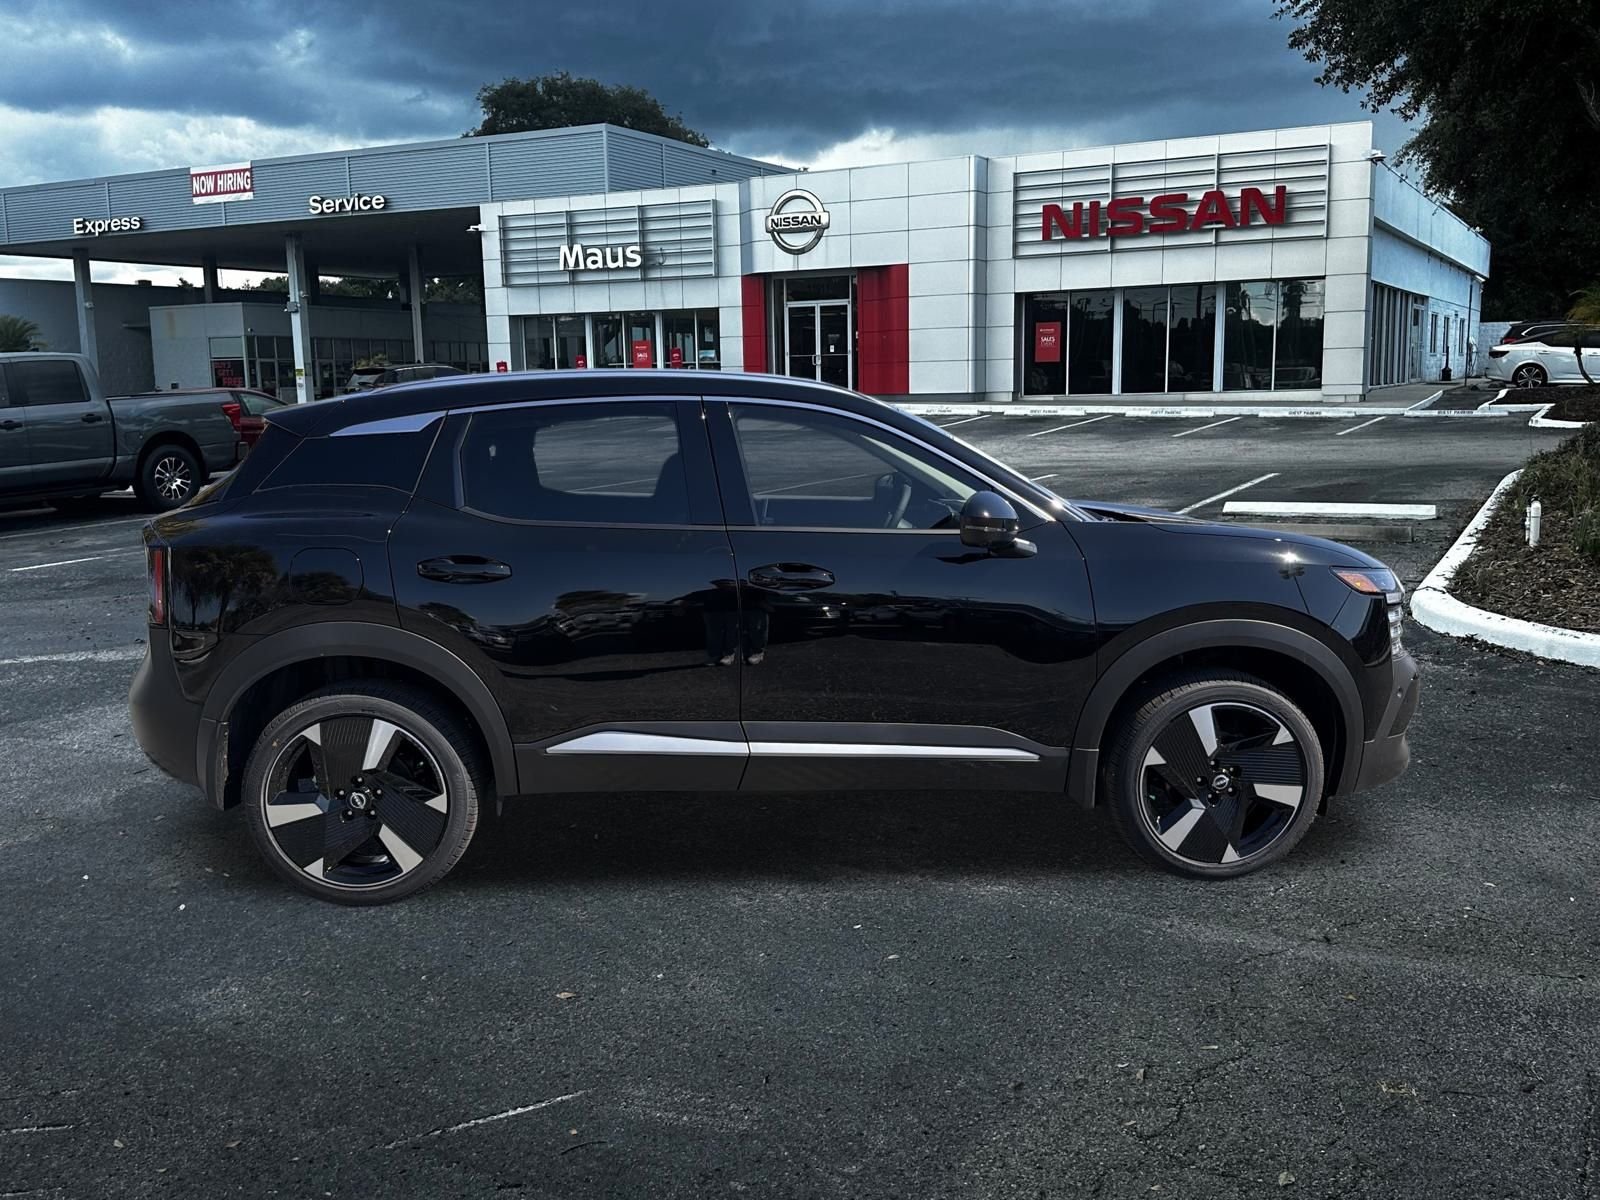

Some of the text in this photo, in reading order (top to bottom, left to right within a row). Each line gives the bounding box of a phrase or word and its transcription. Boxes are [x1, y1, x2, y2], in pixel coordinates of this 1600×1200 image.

[193, 171, 251, 195] NOW HIRING
[309, 192, 385, 214] Service
[1042, 185, 1287, 241] NISSAN
[73, 216, 141, 237] Express
[770, 215, 822, 228] NISSAN
[560, 243, 642, 271] Maus
